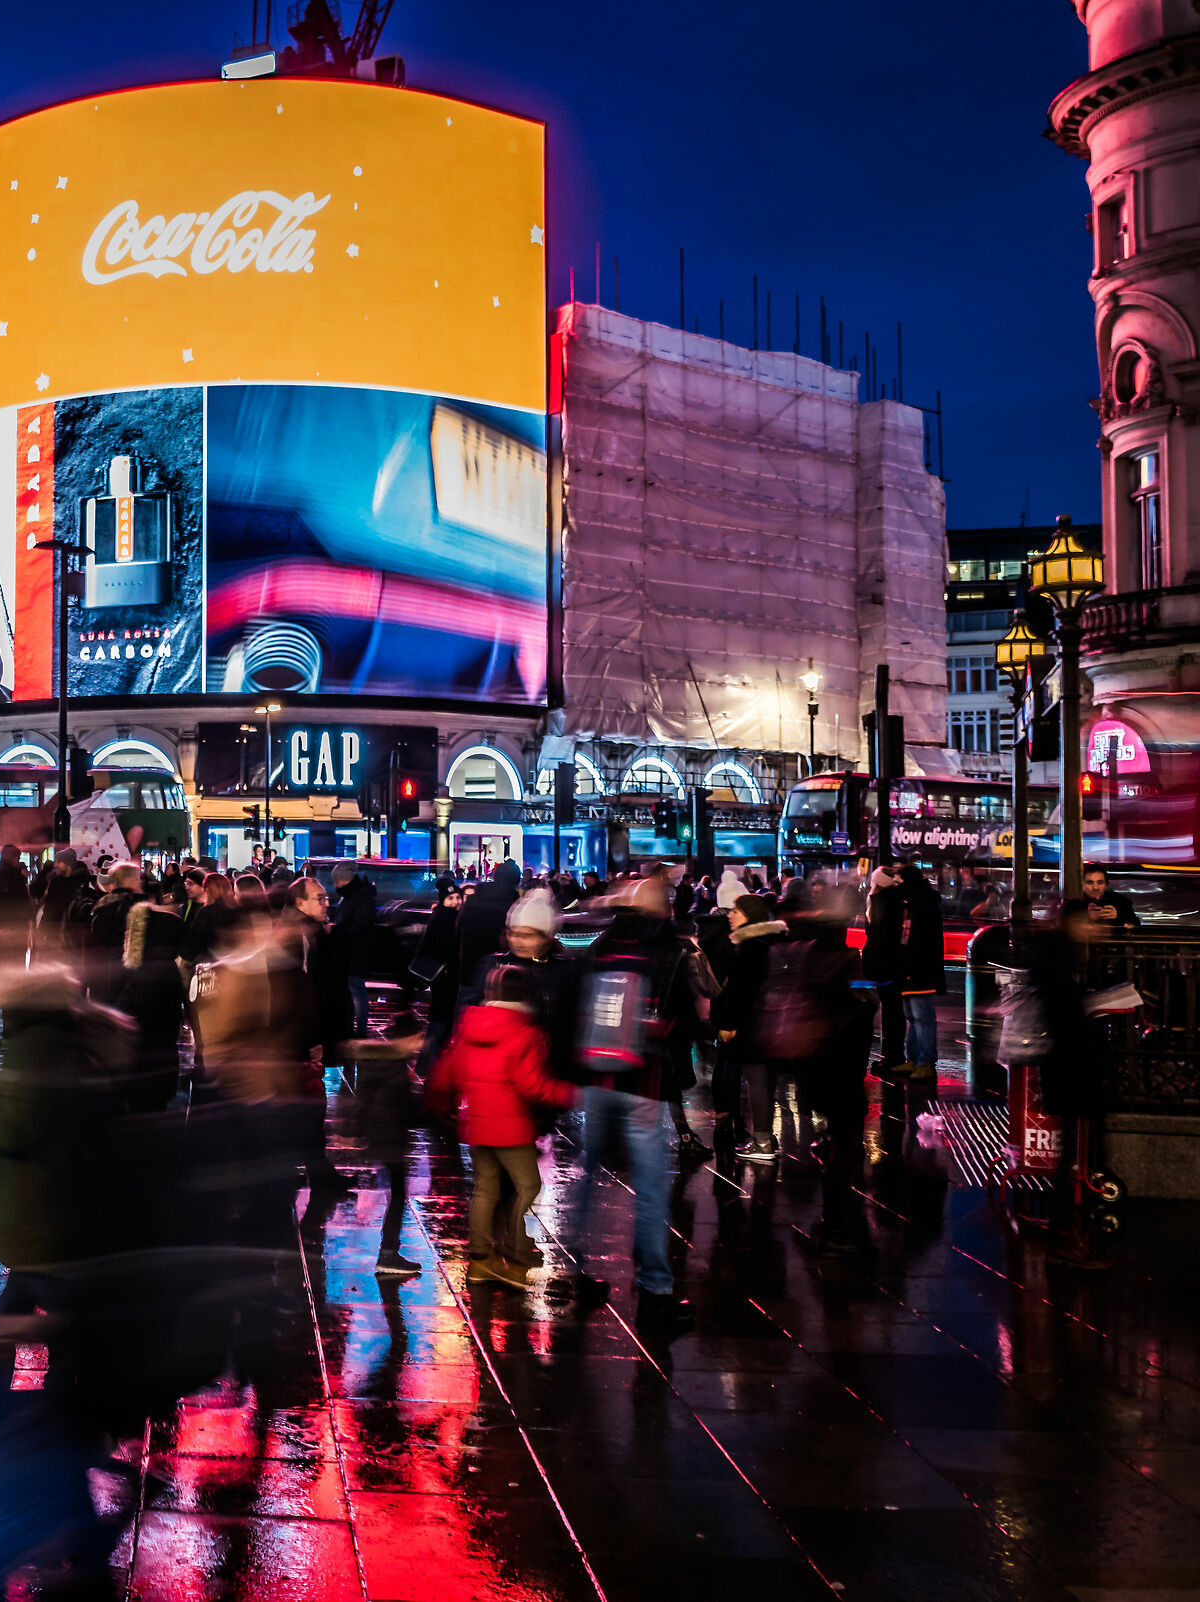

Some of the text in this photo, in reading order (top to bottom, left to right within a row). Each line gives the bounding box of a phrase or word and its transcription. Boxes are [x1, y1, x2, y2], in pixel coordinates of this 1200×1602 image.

[82, 190, 332, 286] Coca-Cola
[26, 415, 41, 550] PRADA
[80, 627, 171, 642] LUNA ROSSA
[80, 642, 172, 661] CARBON
[291, 730, 360, 785] GAP
[891, 826, 922, 845] Now
[924, 827, 979, 850] alighting
[1024, 1128, 1063, 1150] FRE
